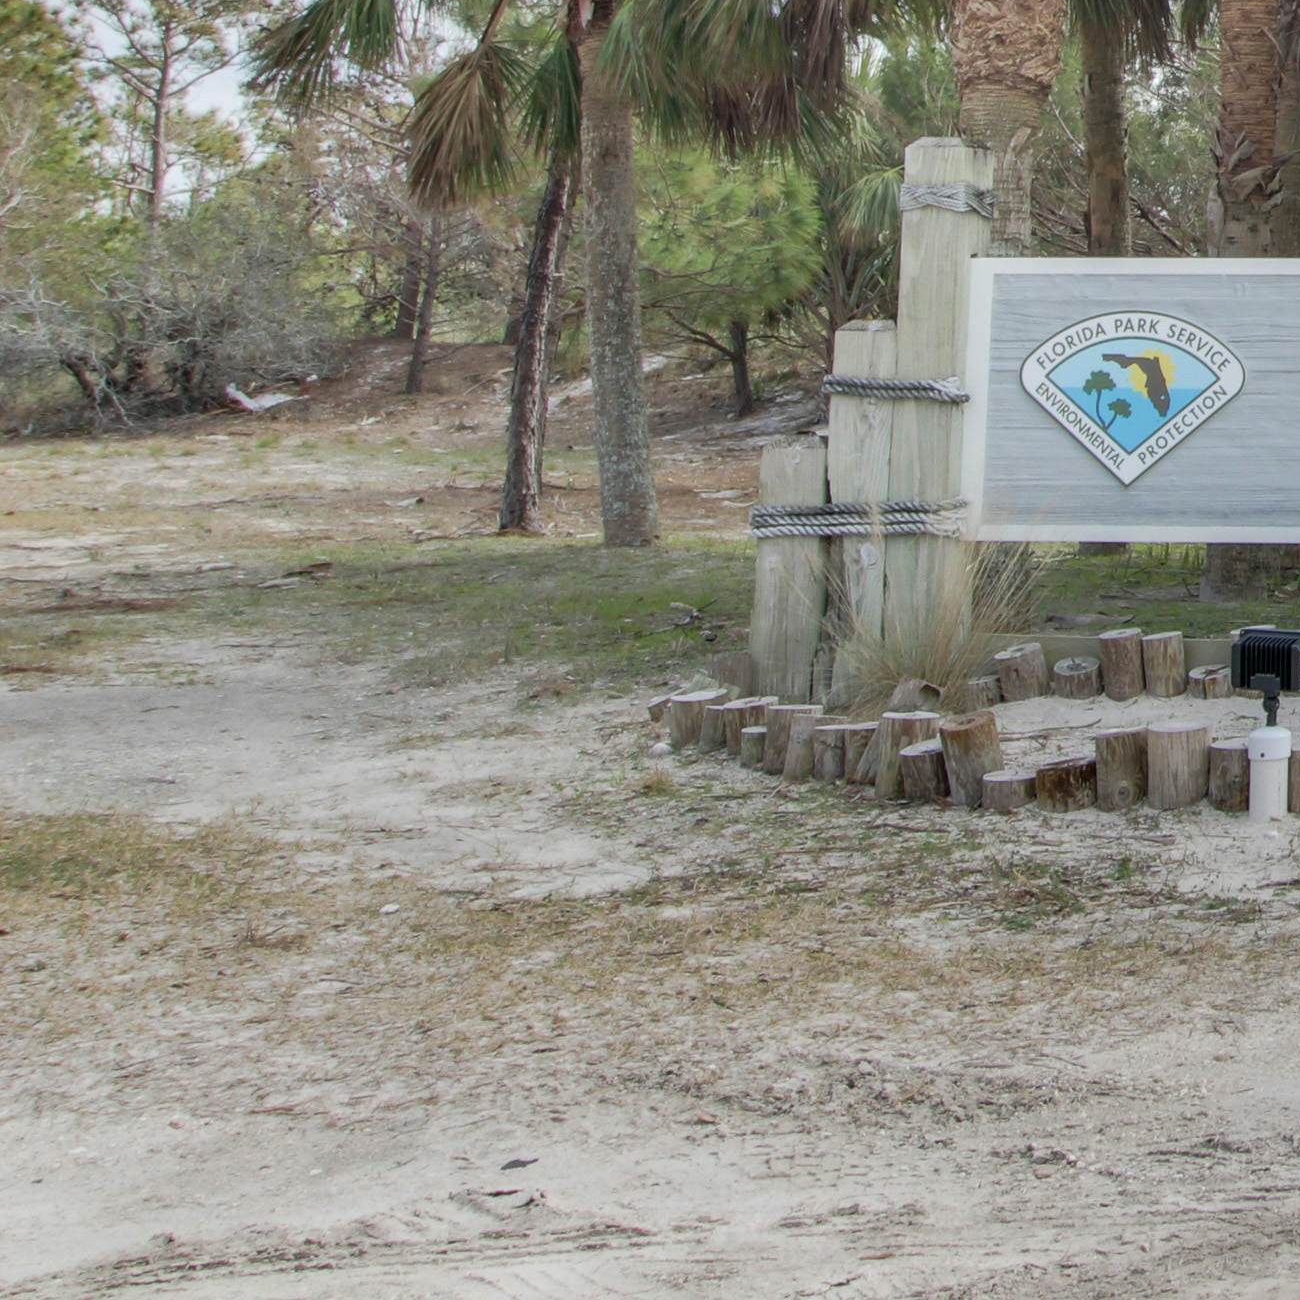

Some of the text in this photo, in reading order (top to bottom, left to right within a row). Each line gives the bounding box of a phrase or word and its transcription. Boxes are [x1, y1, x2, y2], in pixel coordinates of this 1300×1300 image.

[1036, 317, 1231, 373] FLORIDA PARK SERVICE
[1035, 382, 1125, 471] ENVIRONMENTAL
[1137, 385, 1228, 465] PROTECTION
